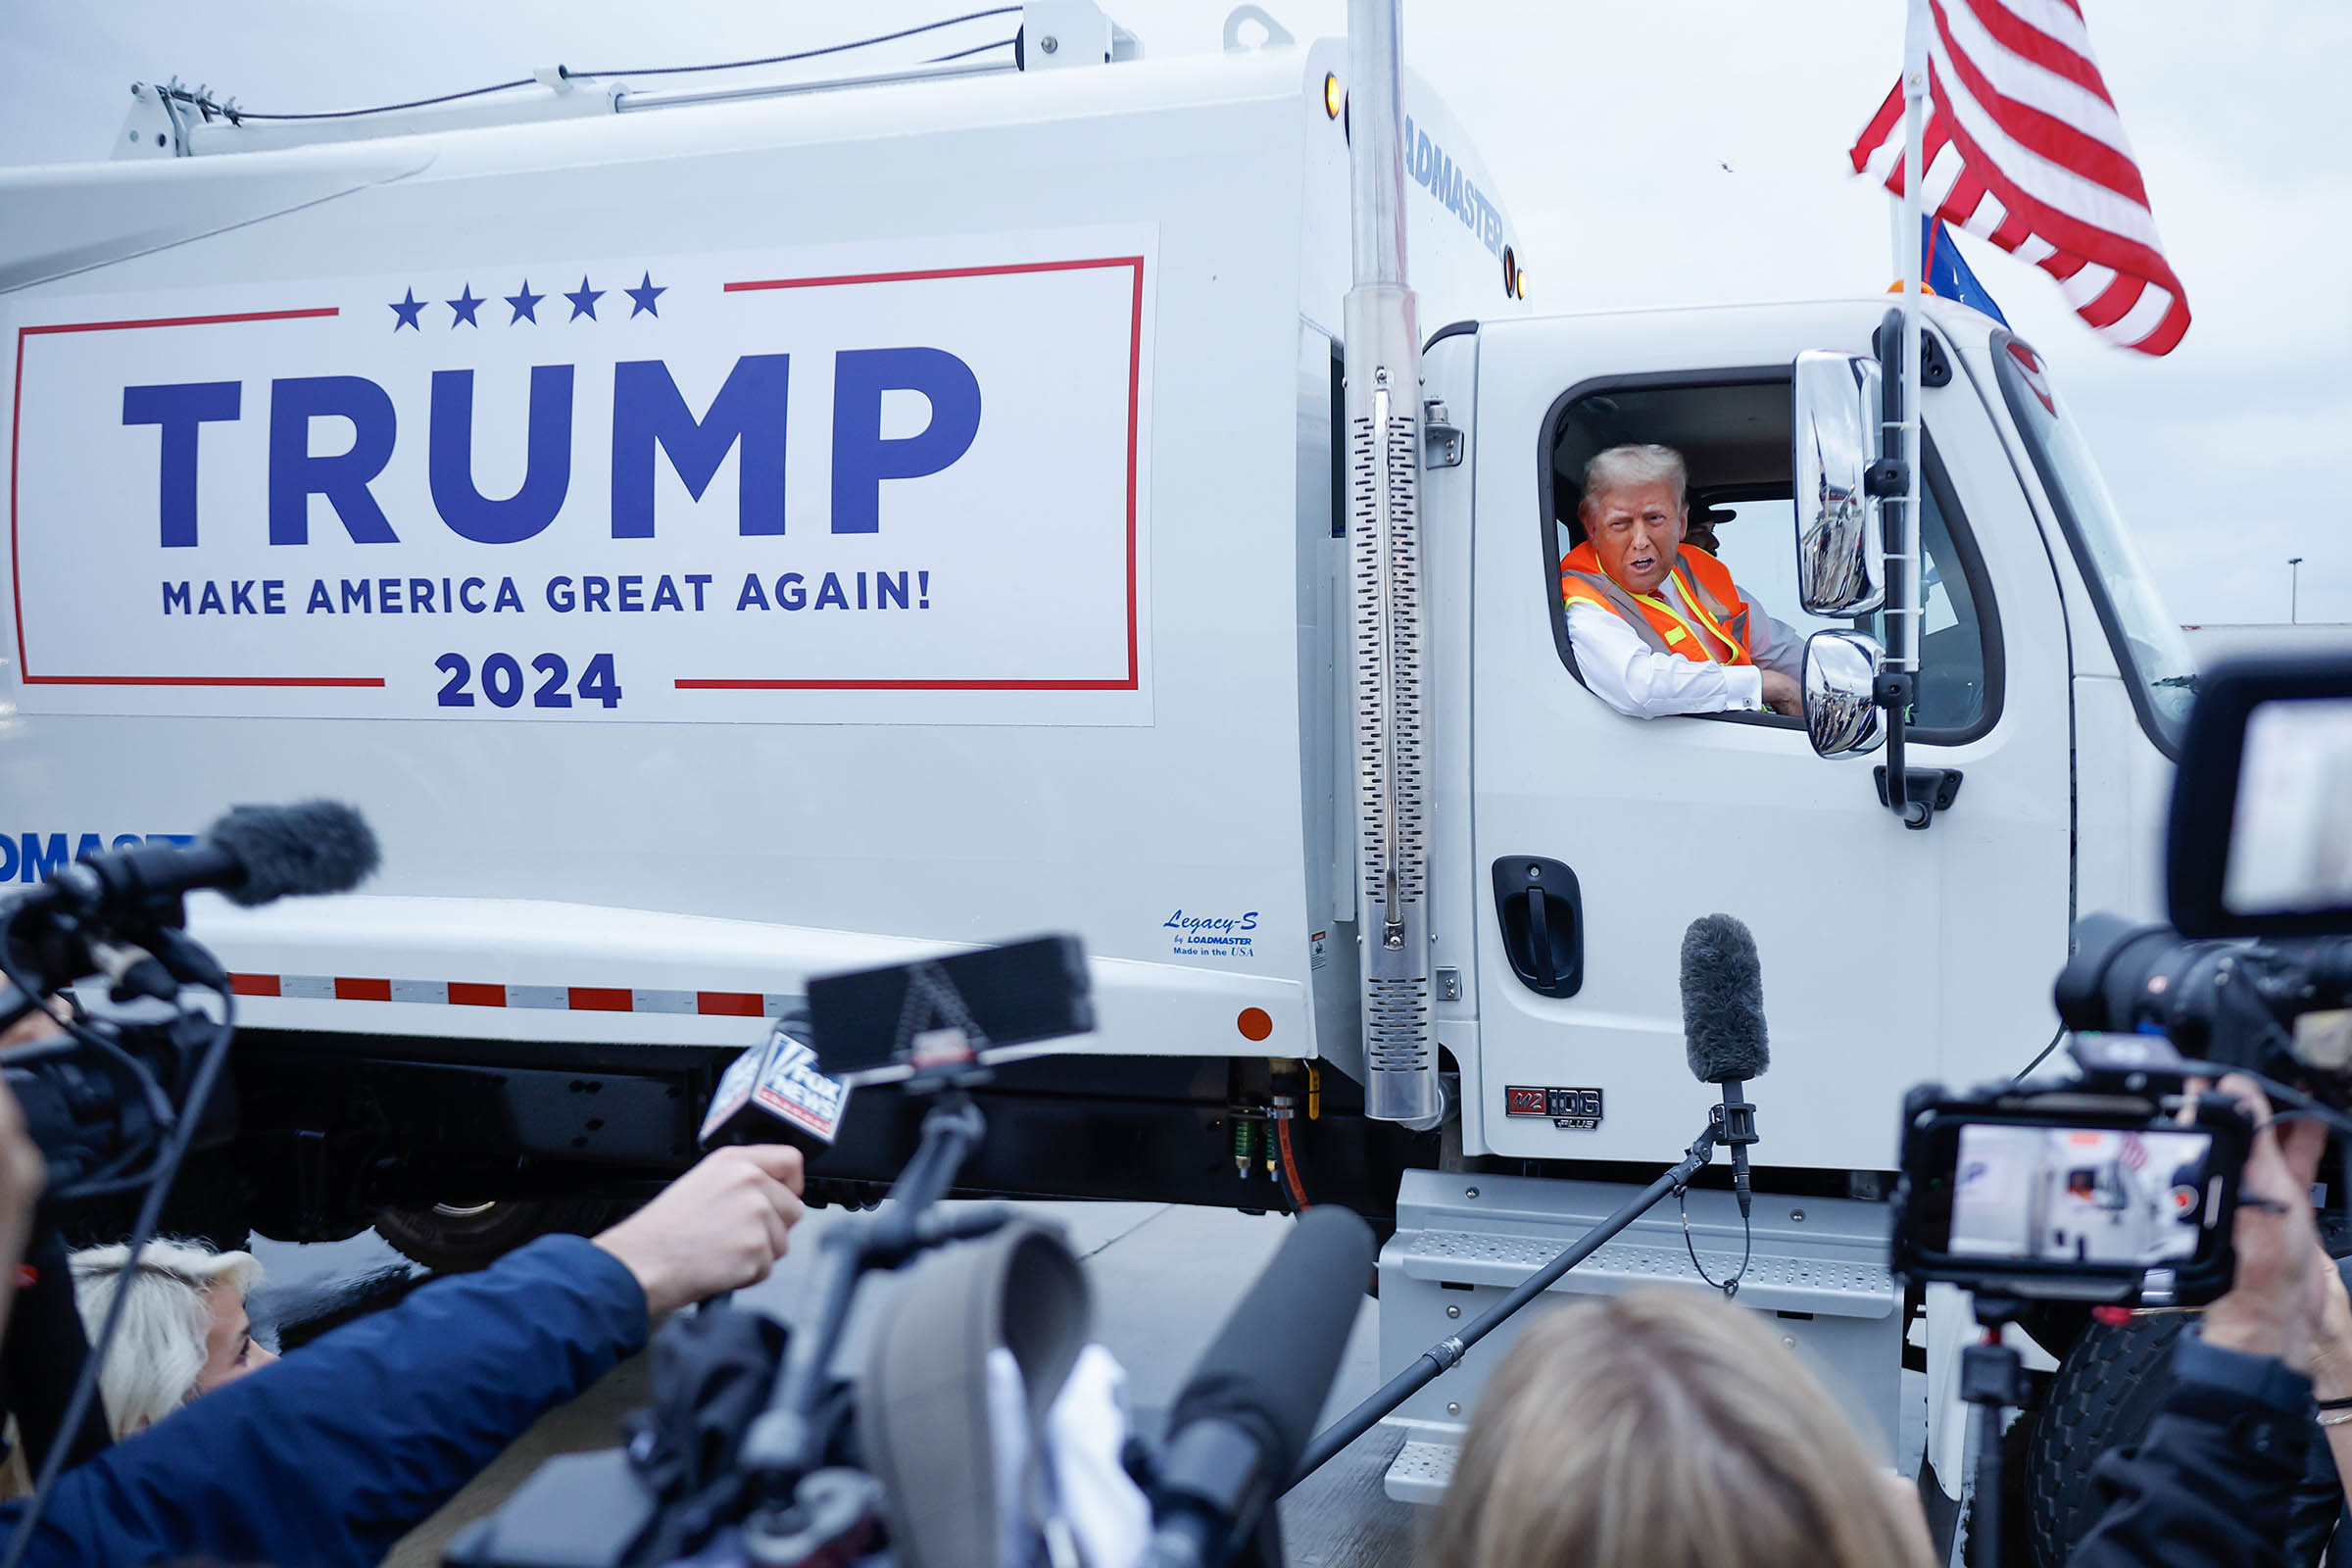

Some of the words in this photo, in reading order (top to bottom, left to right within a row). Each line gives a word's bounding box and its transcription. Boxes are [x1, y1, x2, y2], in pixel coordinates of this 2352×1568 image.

[122, 347, 982, 548] TRUMP
[163, 579, 286, 614] MAKE
[308, 576, 524, 614] AMERICA
[546, 574, 712, 612] GREAT
[736, 571, 930, 611] AGAIN!
[435, 653, 622, 709] 2024
[1163, 909, 1258, 934] Legacy-S
[1173, 947, 1199, 956] Made
[1211, 948, 1227, 956] the
[1231, 947, 1254, 957] USA
[1174, 934, 1184, 944] by
[1187, 936, 1252, 946] LOADMASTER
[1512, 1092, 1544, 1110] M2
[1548, 1089, 1600, 1116] 106
